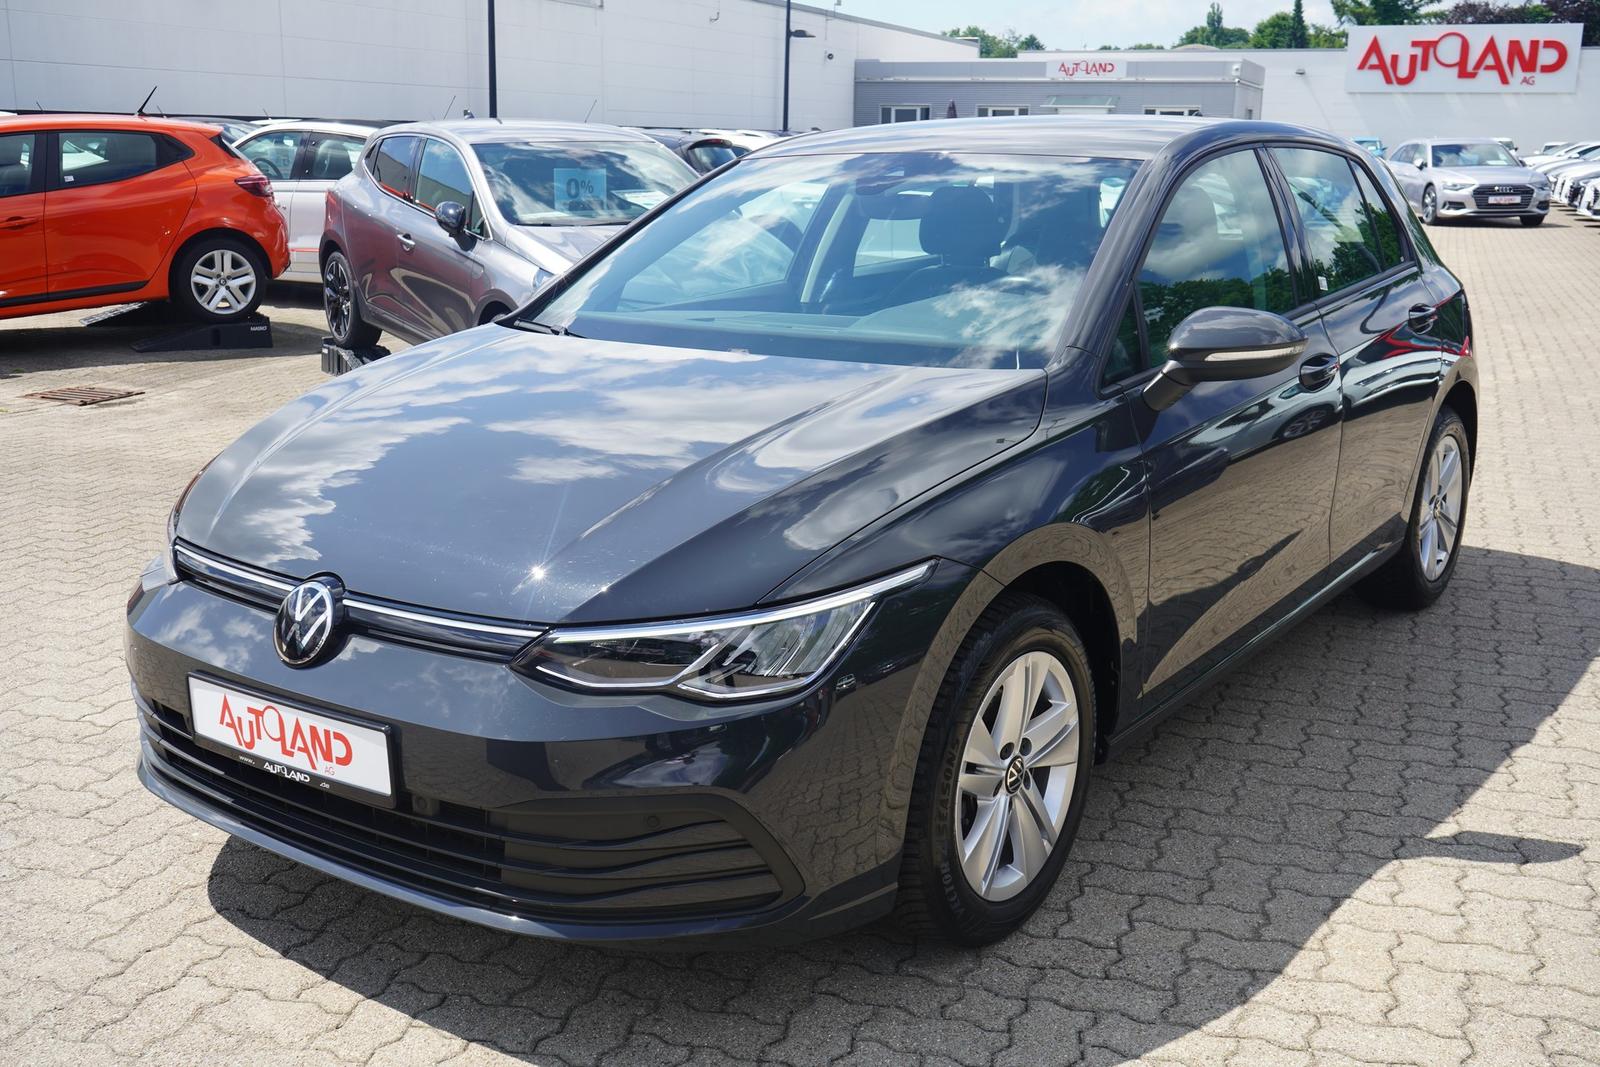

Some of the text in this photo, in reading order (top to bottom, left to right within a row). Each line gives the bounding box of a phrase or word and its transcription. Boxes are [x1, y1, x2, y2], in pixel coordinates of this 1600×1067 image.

[1058, 60, 1114, 77] AUTOLAND
[1357, 31, 1568, 86] AUTOLAND
[1520, 75, 1535, 86] AG
[565, 178, 594, 199] 0%
[218, 693, 353, 771] AUTOLAND
[263, 761, 311, 783] AUTOLAND
[323, 765, 336, 777] AG
